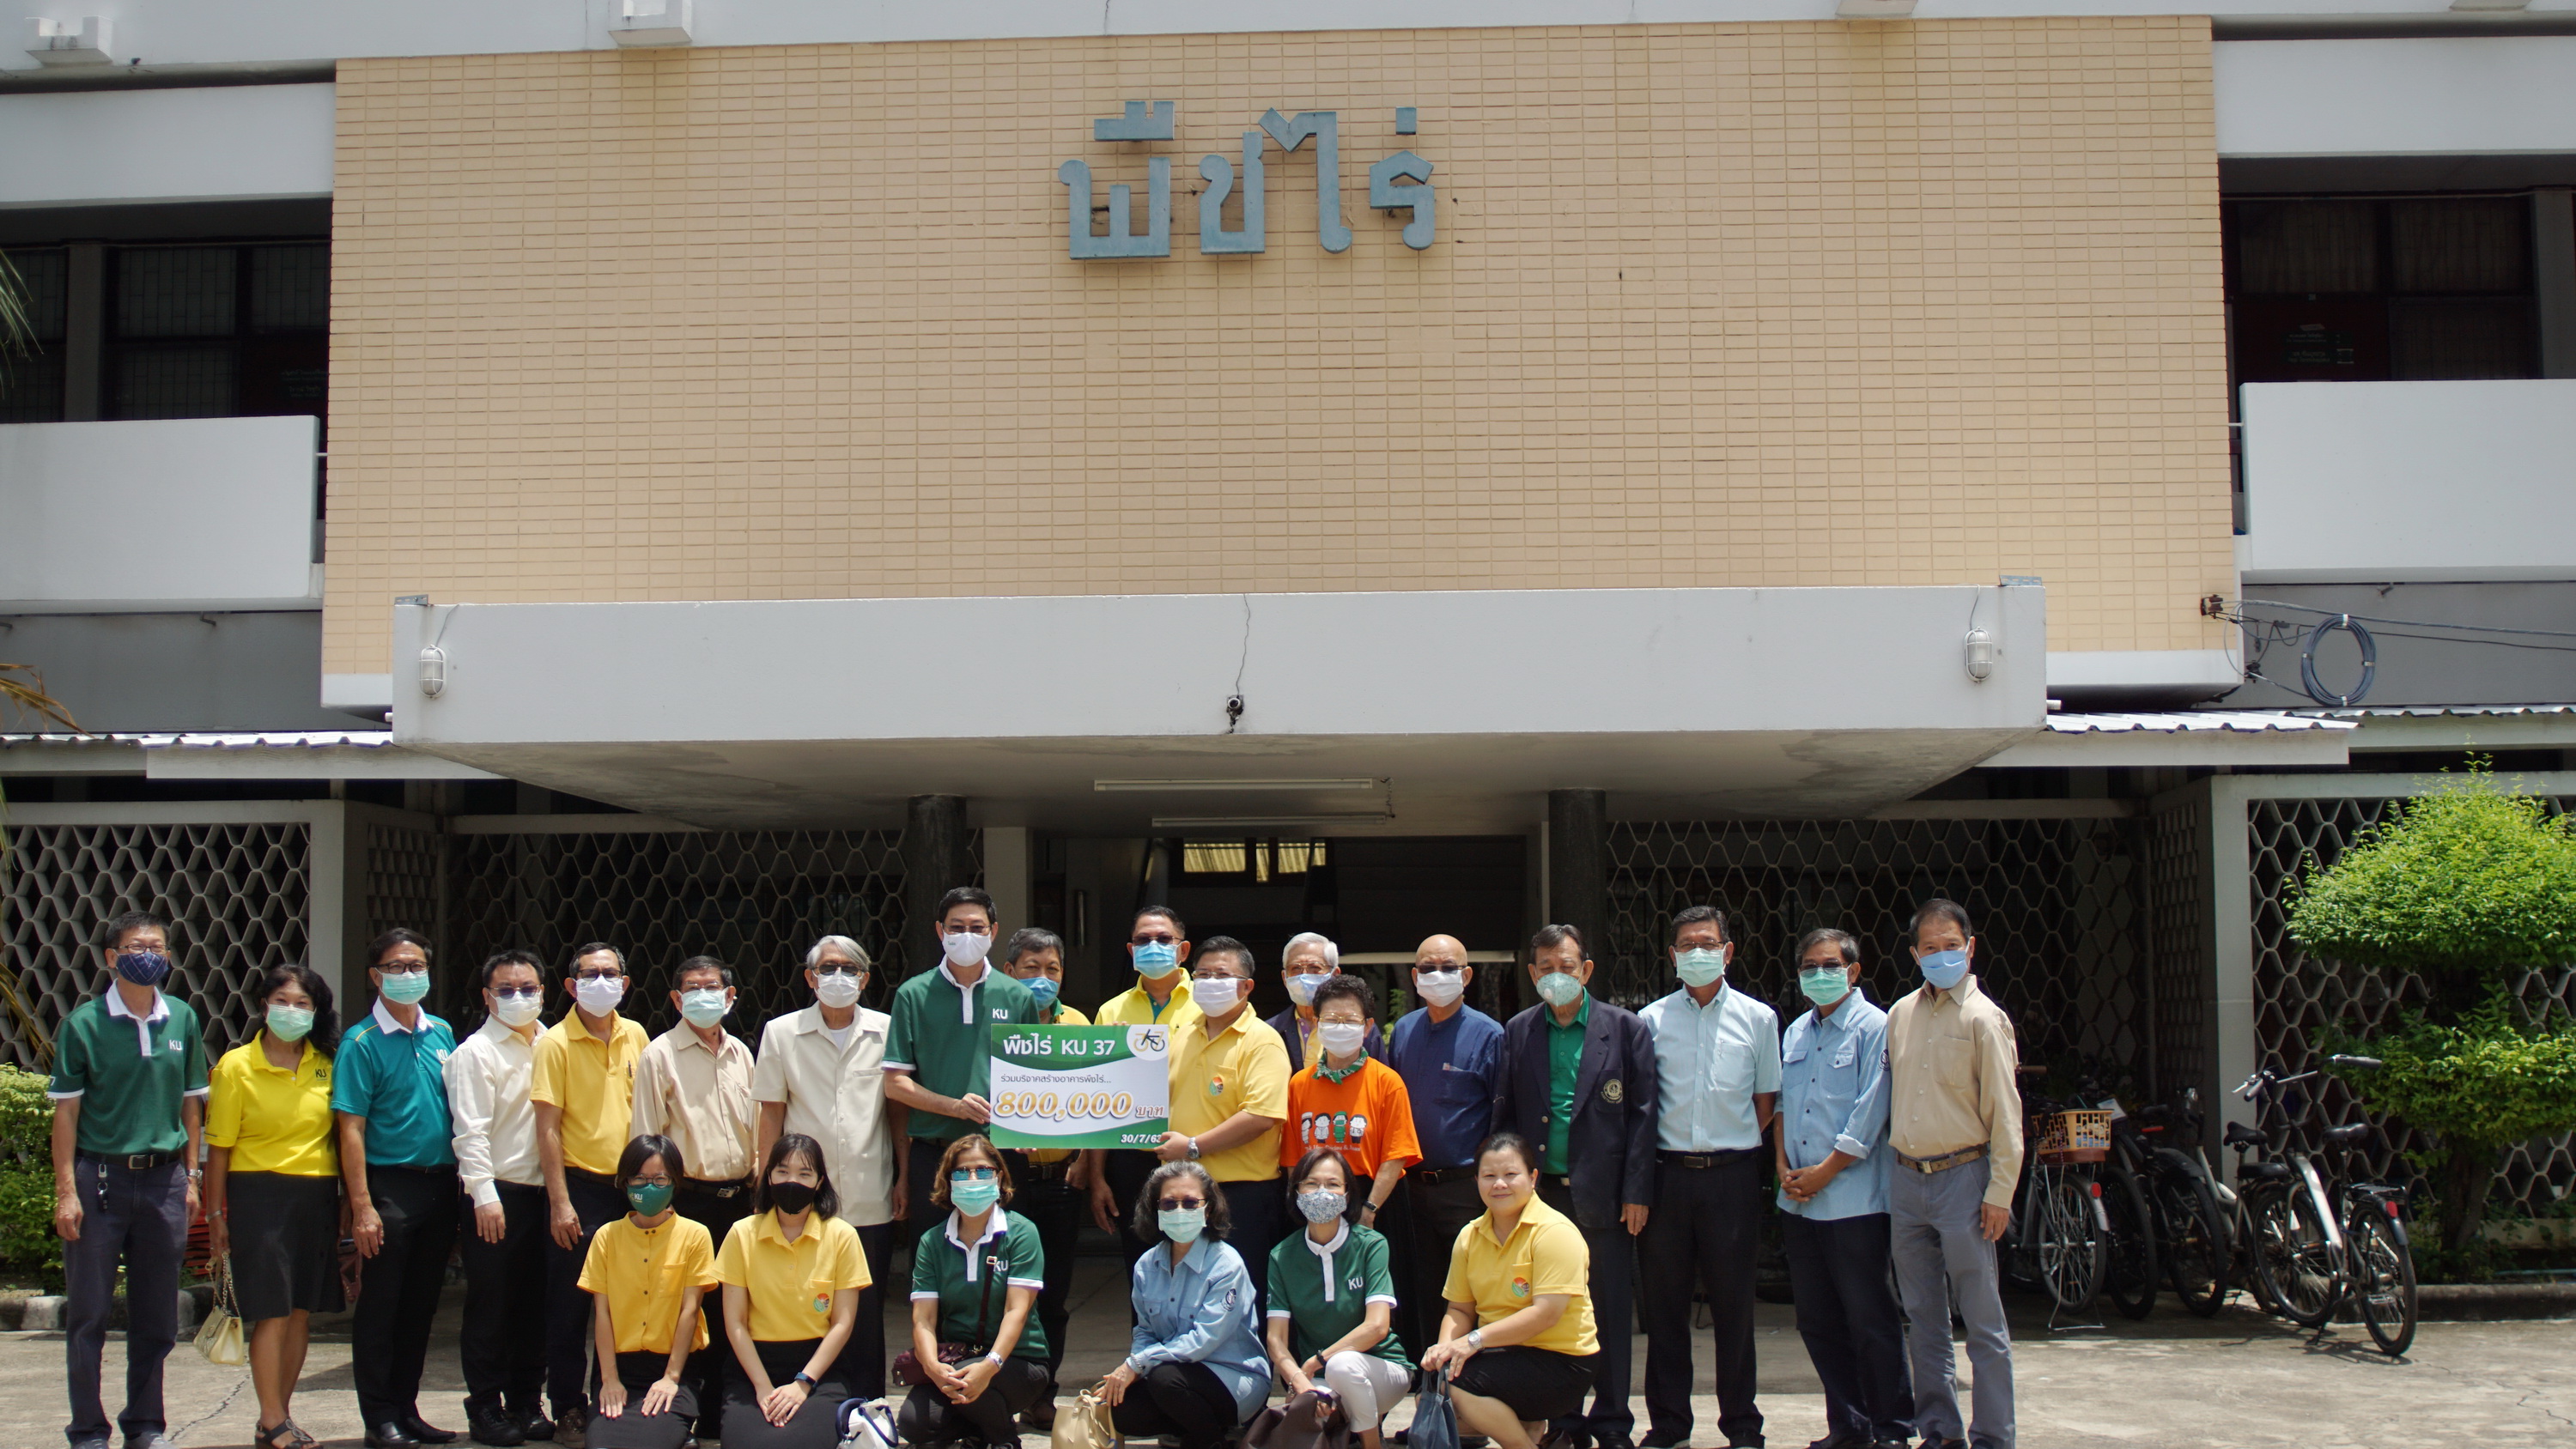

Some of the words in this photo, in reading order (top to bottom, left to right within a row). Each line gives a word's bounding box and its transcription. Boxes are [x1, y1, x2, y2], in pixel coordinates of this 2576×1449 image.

[1057, 100, 1435, 260] พืชไร่
[992, 1008, 1008, 1020] KU
[168, 1039, 183, 1052] KU
[1003, 1032, 1053, 1055] พืชไร่
[1061, 1040, 1087, 1055] KU
[1093, 1040, 1115, 1056] 37
[435, 1048, 448, 1061] KU
[314, 1068, 327, 1078] KU
[994, 1090, 1133, 1121] 800,000
[1136, 1105, 1164, 1119] บาท
[1121, 1133, 1162, 1144] 30/7/63
[634, 1192, 643, 1201] KU
[993, 1259, 1009, 1272] KU
[1347, 1276, 1364, 1290] KU
